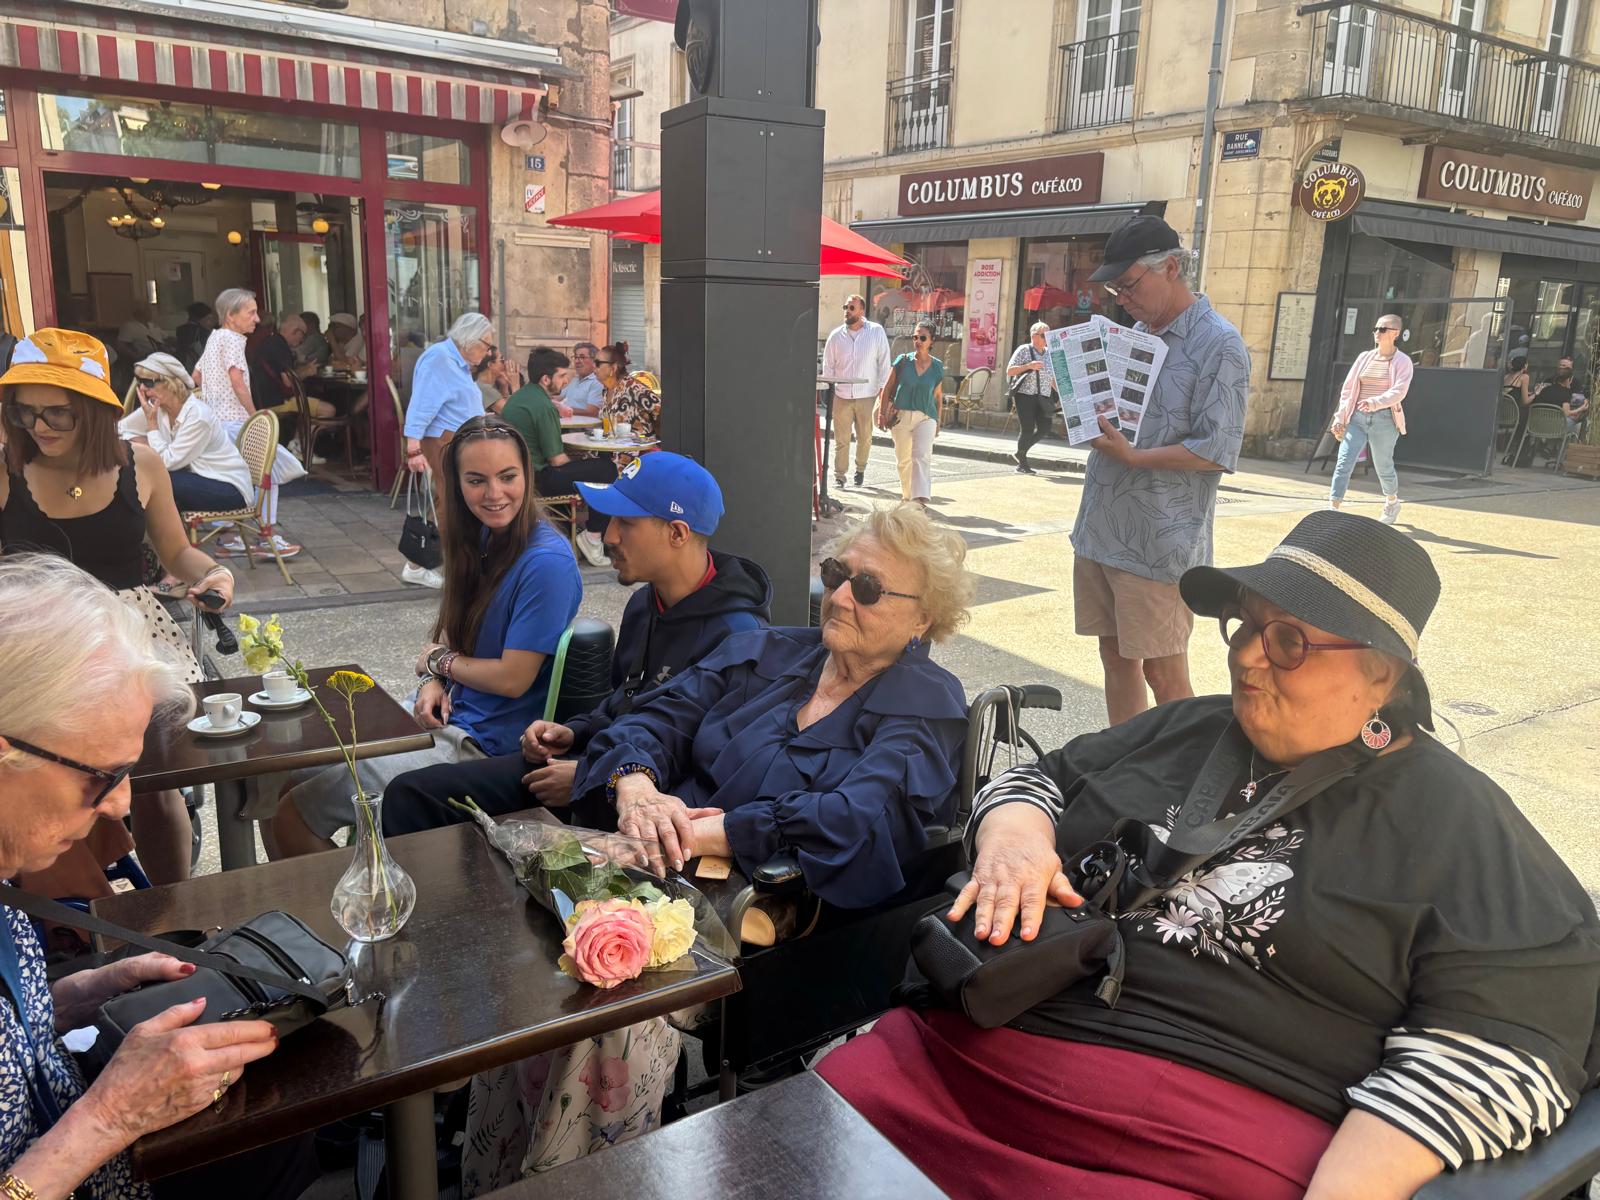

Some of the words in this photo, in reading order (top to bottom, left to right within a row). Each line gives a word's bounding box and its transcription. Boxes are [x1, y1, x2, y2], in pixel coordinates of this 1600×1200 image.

[1234, 133, 1249, 141] RUE
[530, 158, 542, 169] 15
[1303, 163, 1359, 189] COLUMBUS
[907, 172, 1023, 204] COLUMBUS
[1031, 177, 1083, 195] CAFÉ&CO
[1440, 160, 1546, 202] COLUMBUS
[1549, 190, 1583, 209] CAFÉ&CO
